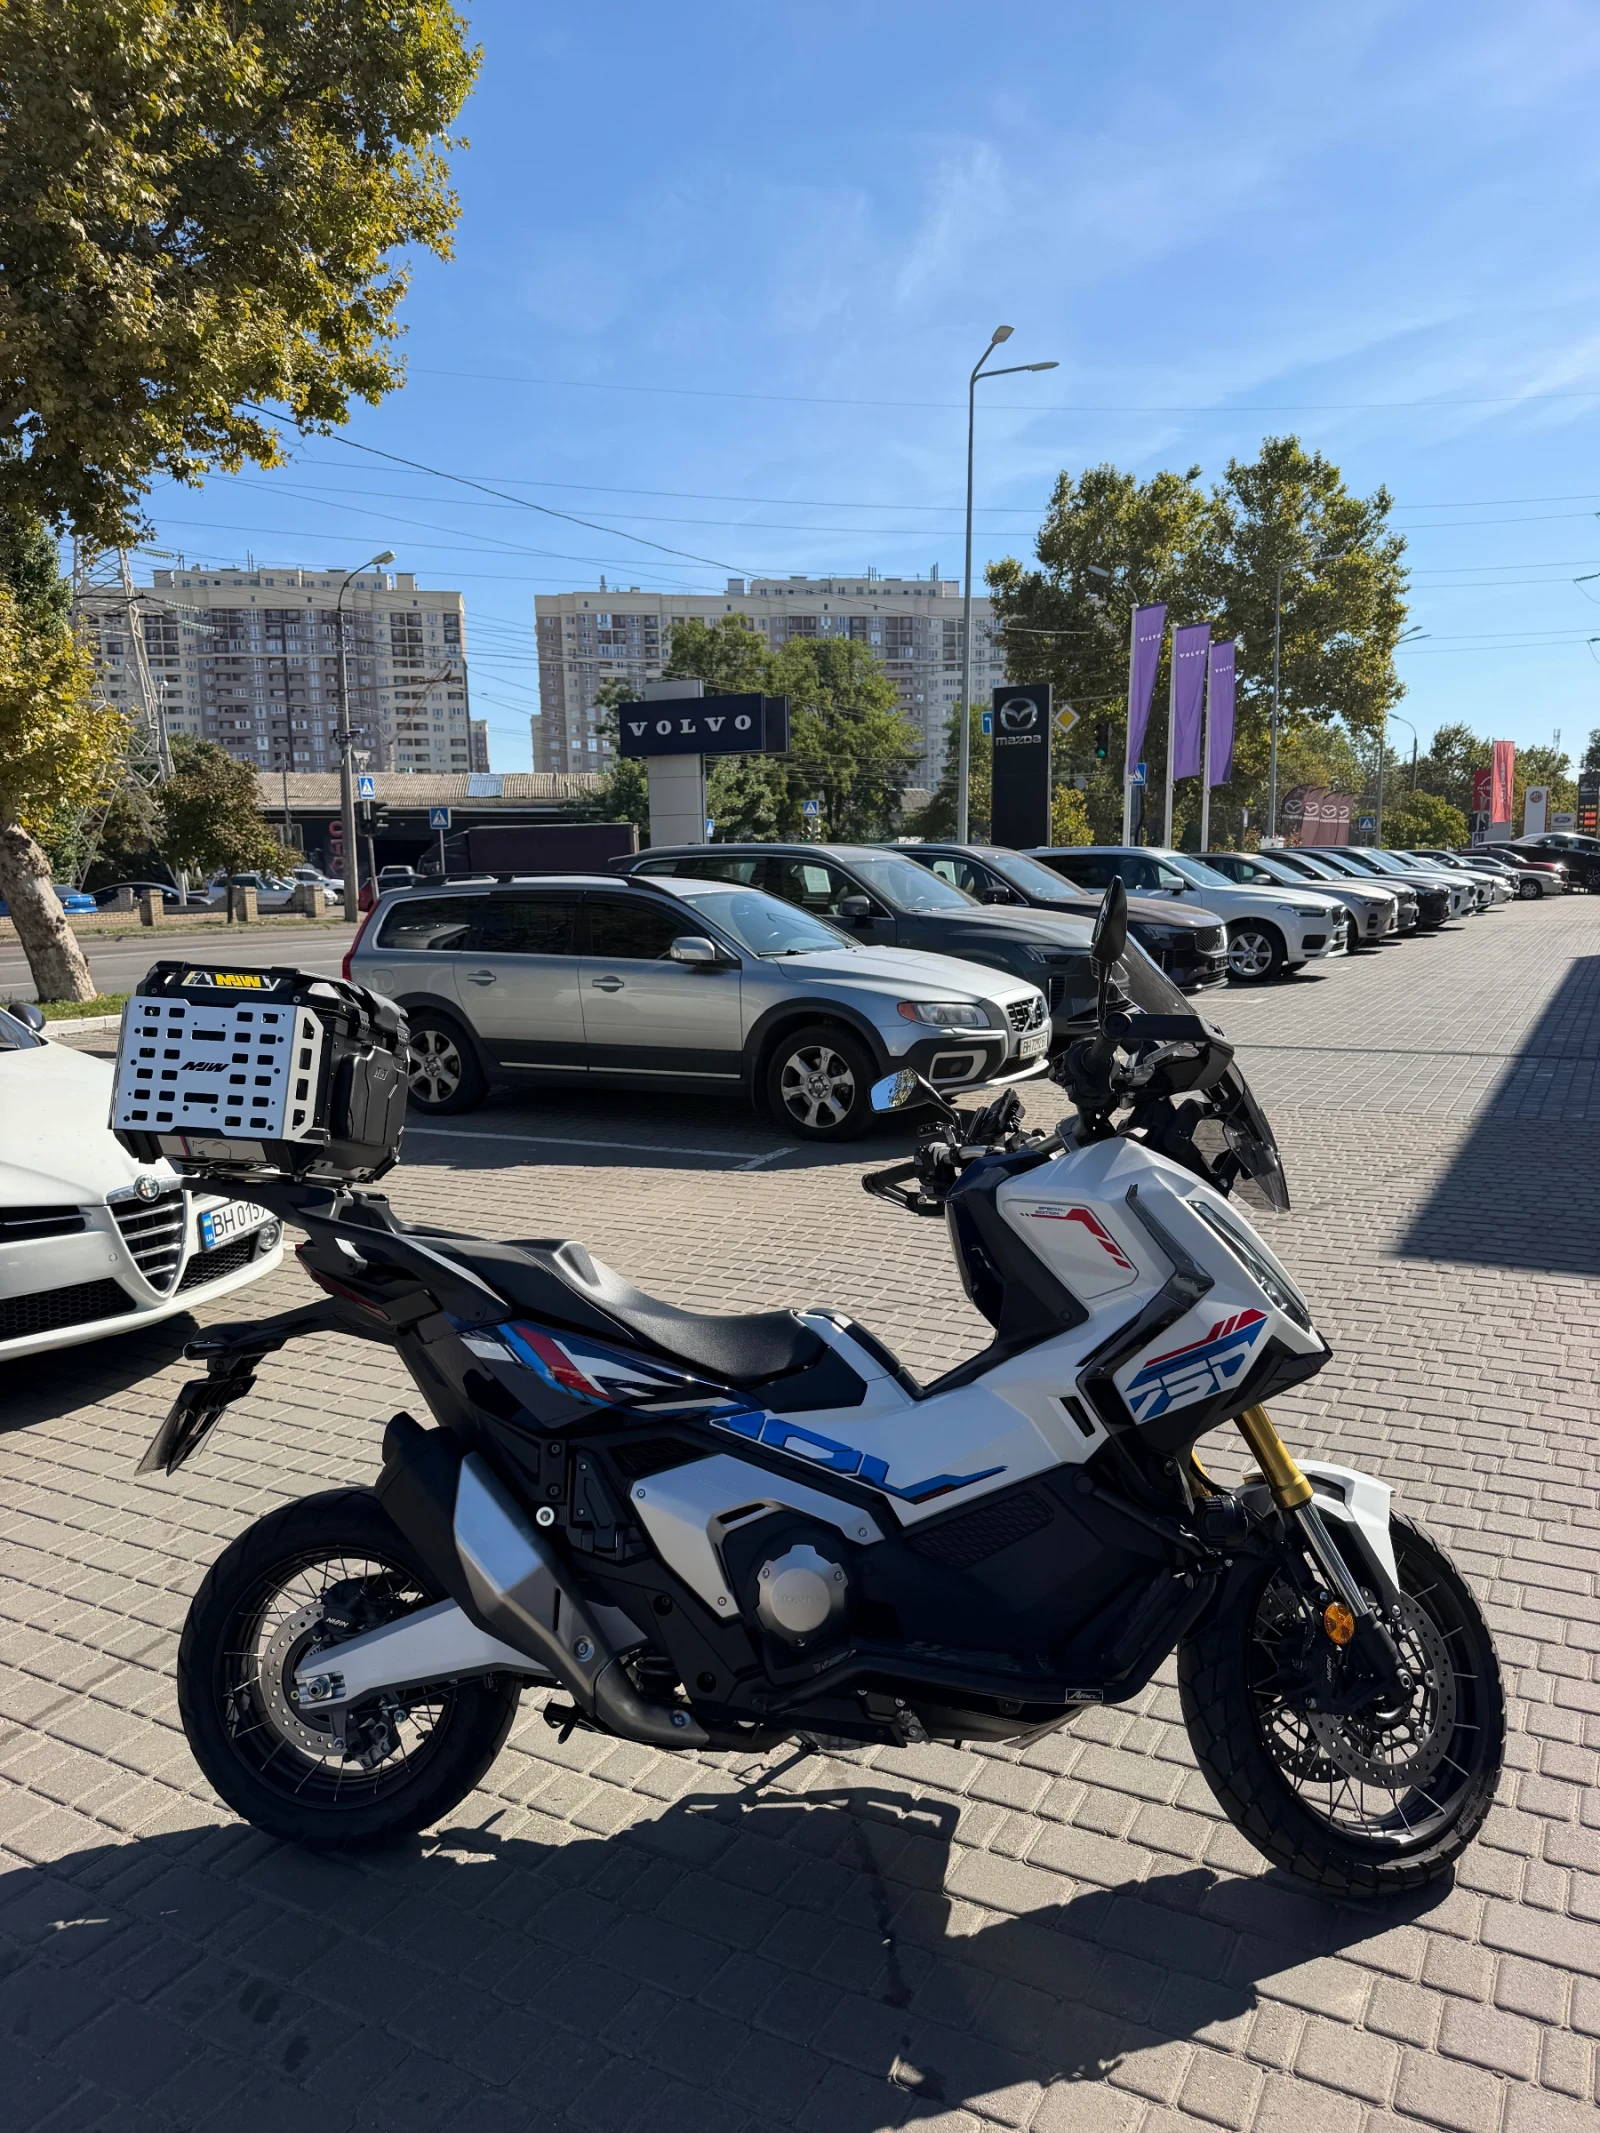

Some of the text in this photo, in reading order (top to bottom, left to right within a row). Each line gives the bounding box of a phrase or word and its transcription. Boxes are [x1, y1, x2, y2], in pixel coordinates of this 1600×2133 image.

[1180, 649, 1206, 658] VOLVO
[628, 714, 752, 736] VOLVO
[212, 1208, 236, 1238] BH
[206, 1233, 215, 1242] UA
